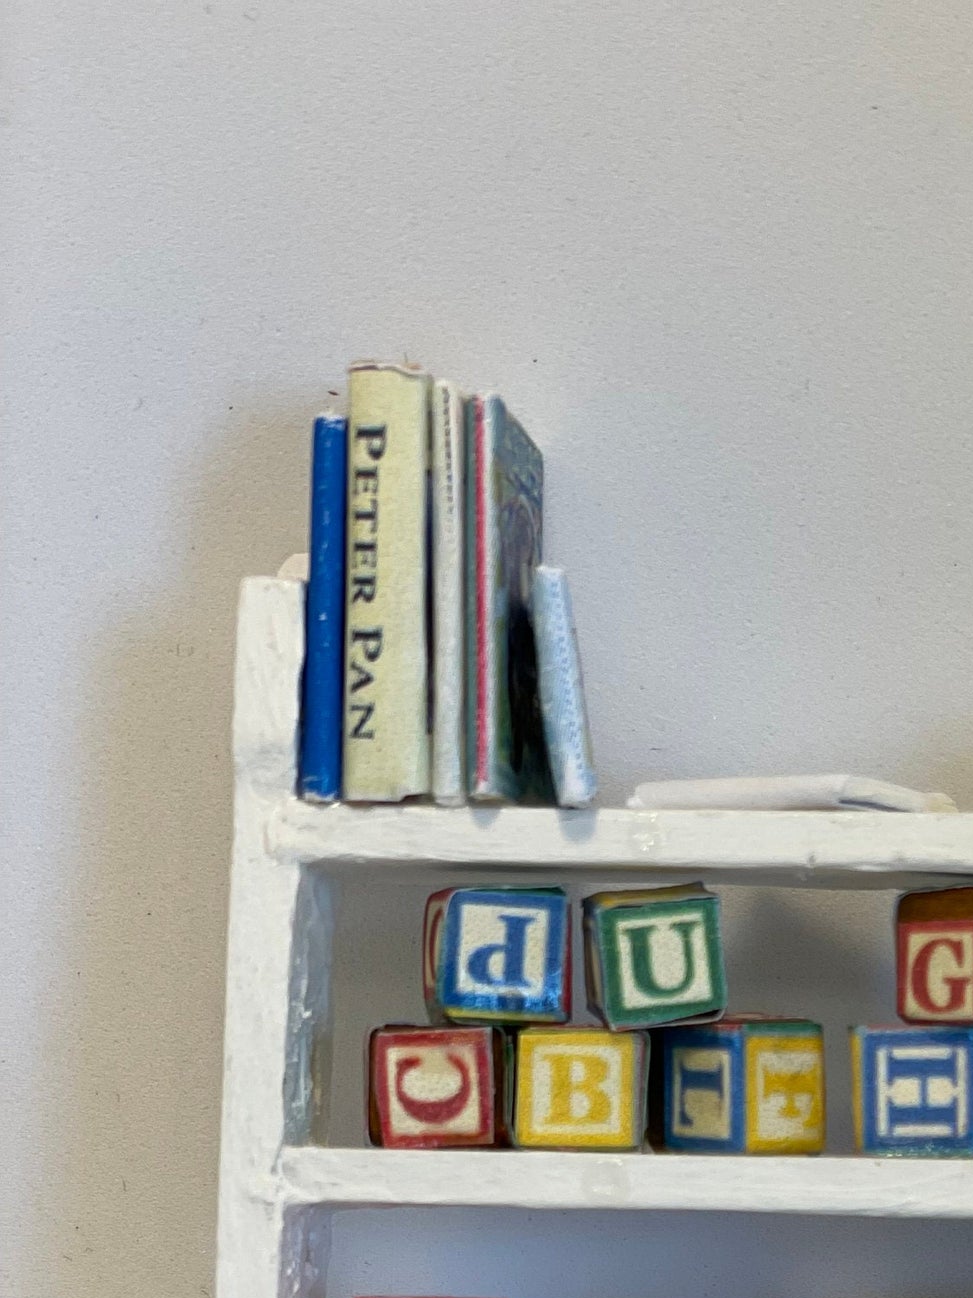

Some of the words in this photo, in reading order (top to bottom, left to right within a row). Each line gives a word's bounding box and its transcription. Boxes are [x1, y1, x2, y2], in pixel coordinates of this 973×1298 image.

[352, 423, 387, 605] PETER
[349, 626, 383, 740] PAN
[622, 920, 699, 998] U
[911, 938, 971, 1014] G
[542, 1052, 612, 1126] B
